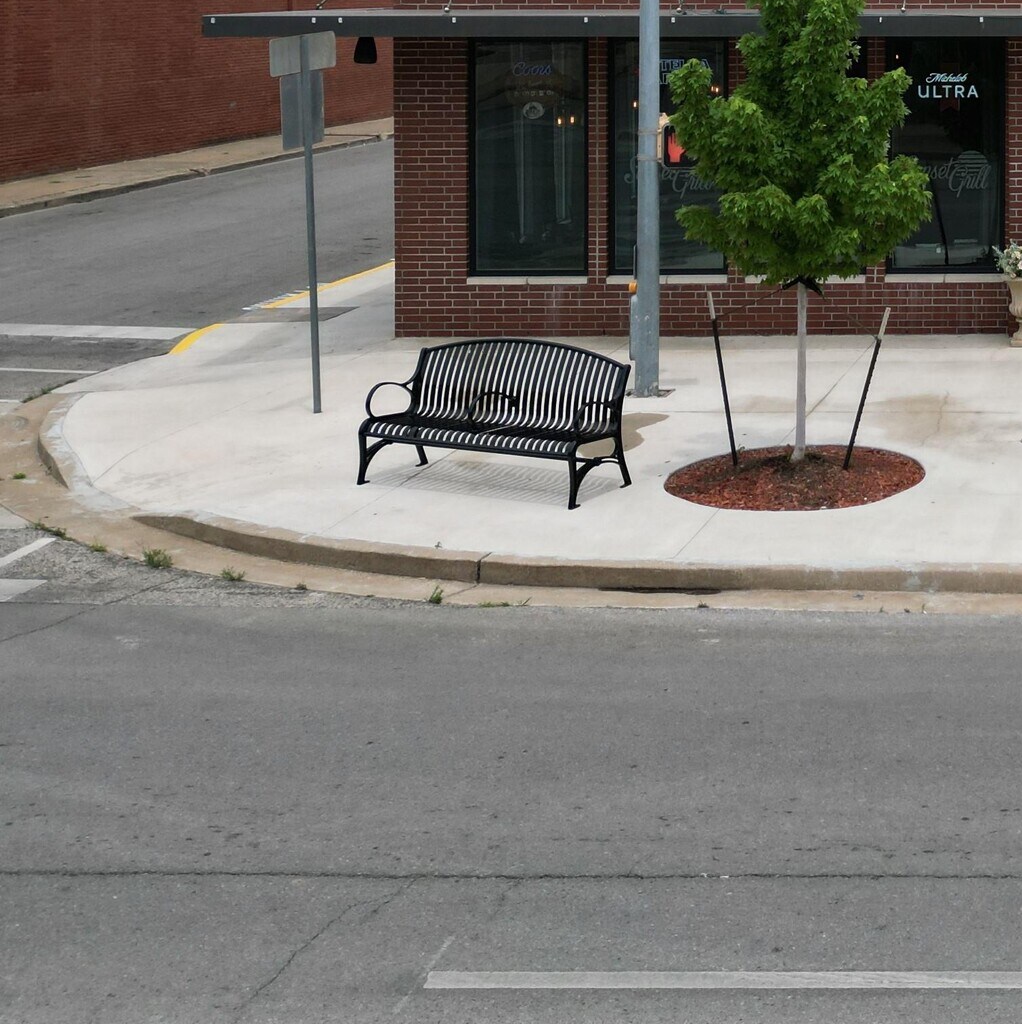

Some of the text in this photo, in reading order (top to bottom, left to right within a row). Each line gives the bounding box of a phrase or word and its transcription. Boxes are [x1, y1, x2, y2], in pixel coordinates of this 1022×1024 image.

[925, 73, 969, 83] Michelob
[917, 85, 979, 98] ULTRA
[948, 164, 992, 198] Grill
